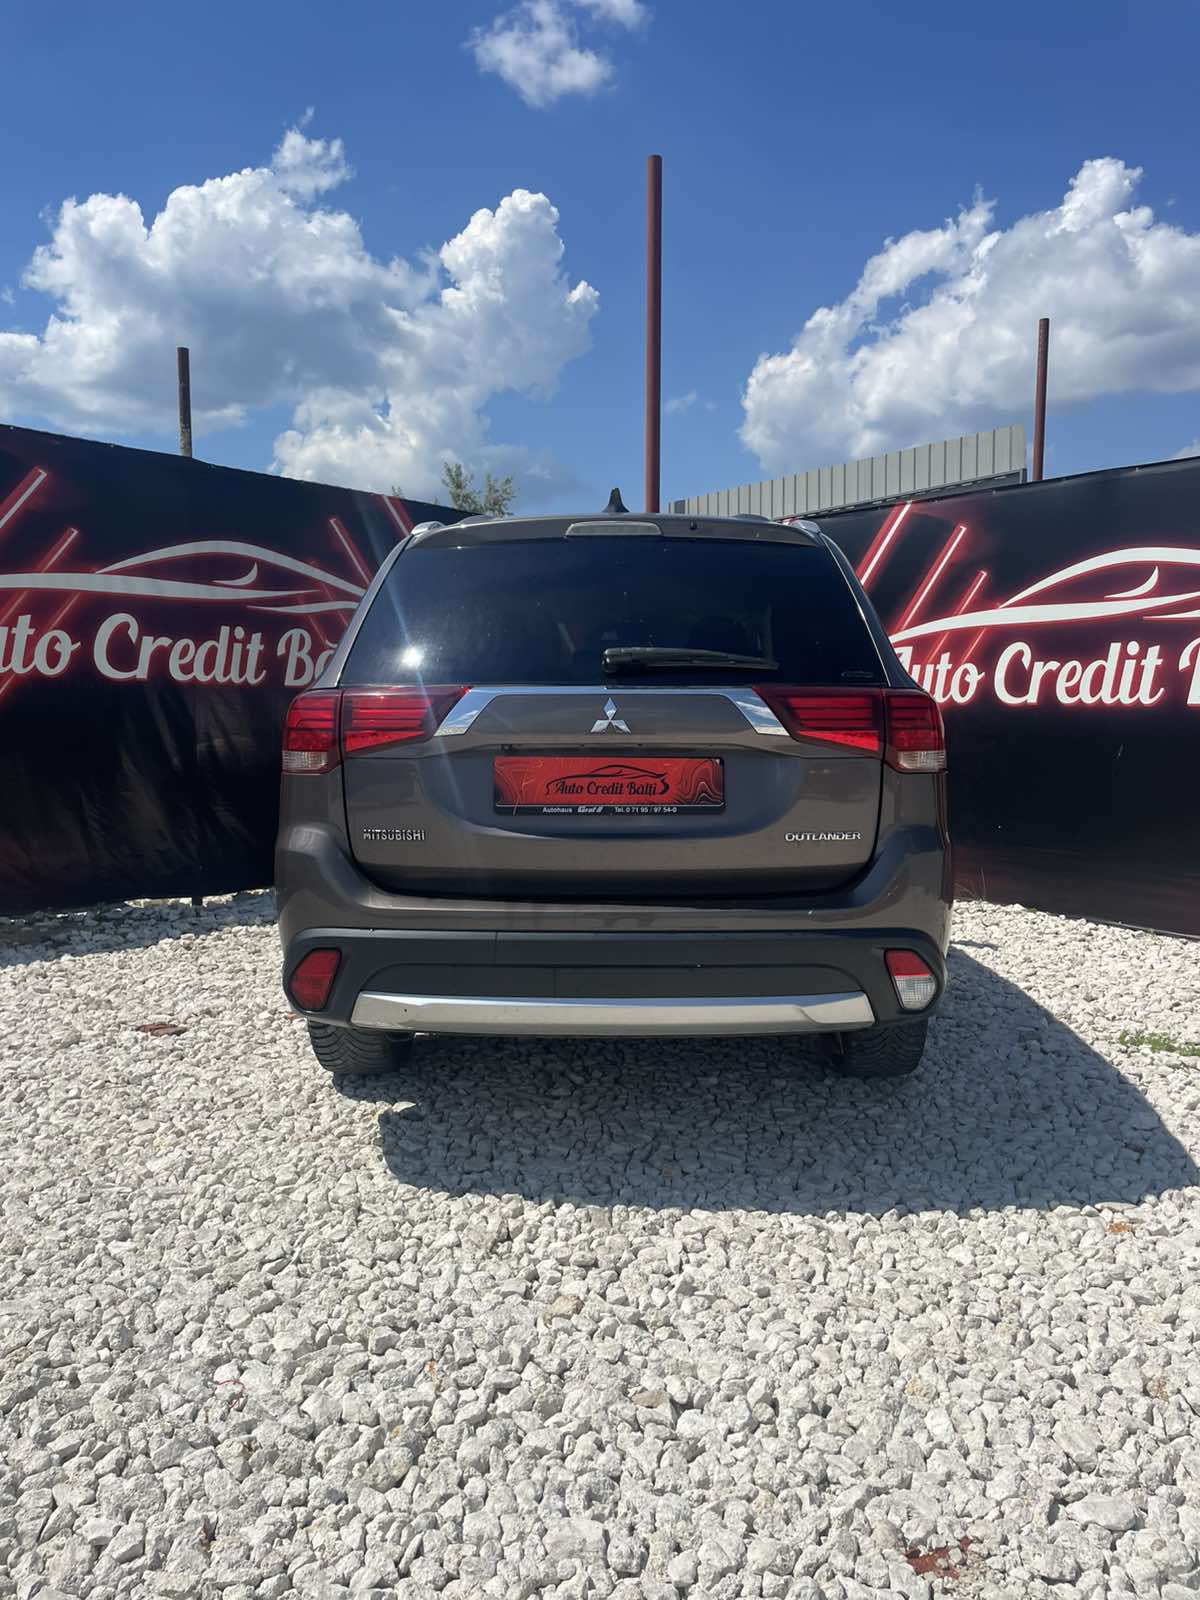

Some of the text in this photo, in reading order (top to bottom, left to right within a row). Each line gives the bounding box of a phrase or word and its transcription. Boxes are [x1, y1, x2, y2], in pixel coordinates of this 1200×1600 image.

[94, 613, 266, 685] Credit
[994, 640, 1164, 704] Credit
[555, 781, 584, 795] Auto
[587, 781, 625, 795] Credit
[363, 829, 425, 841] MITSUBISHI
[785, 831, 861, 841] OUTLANDER
